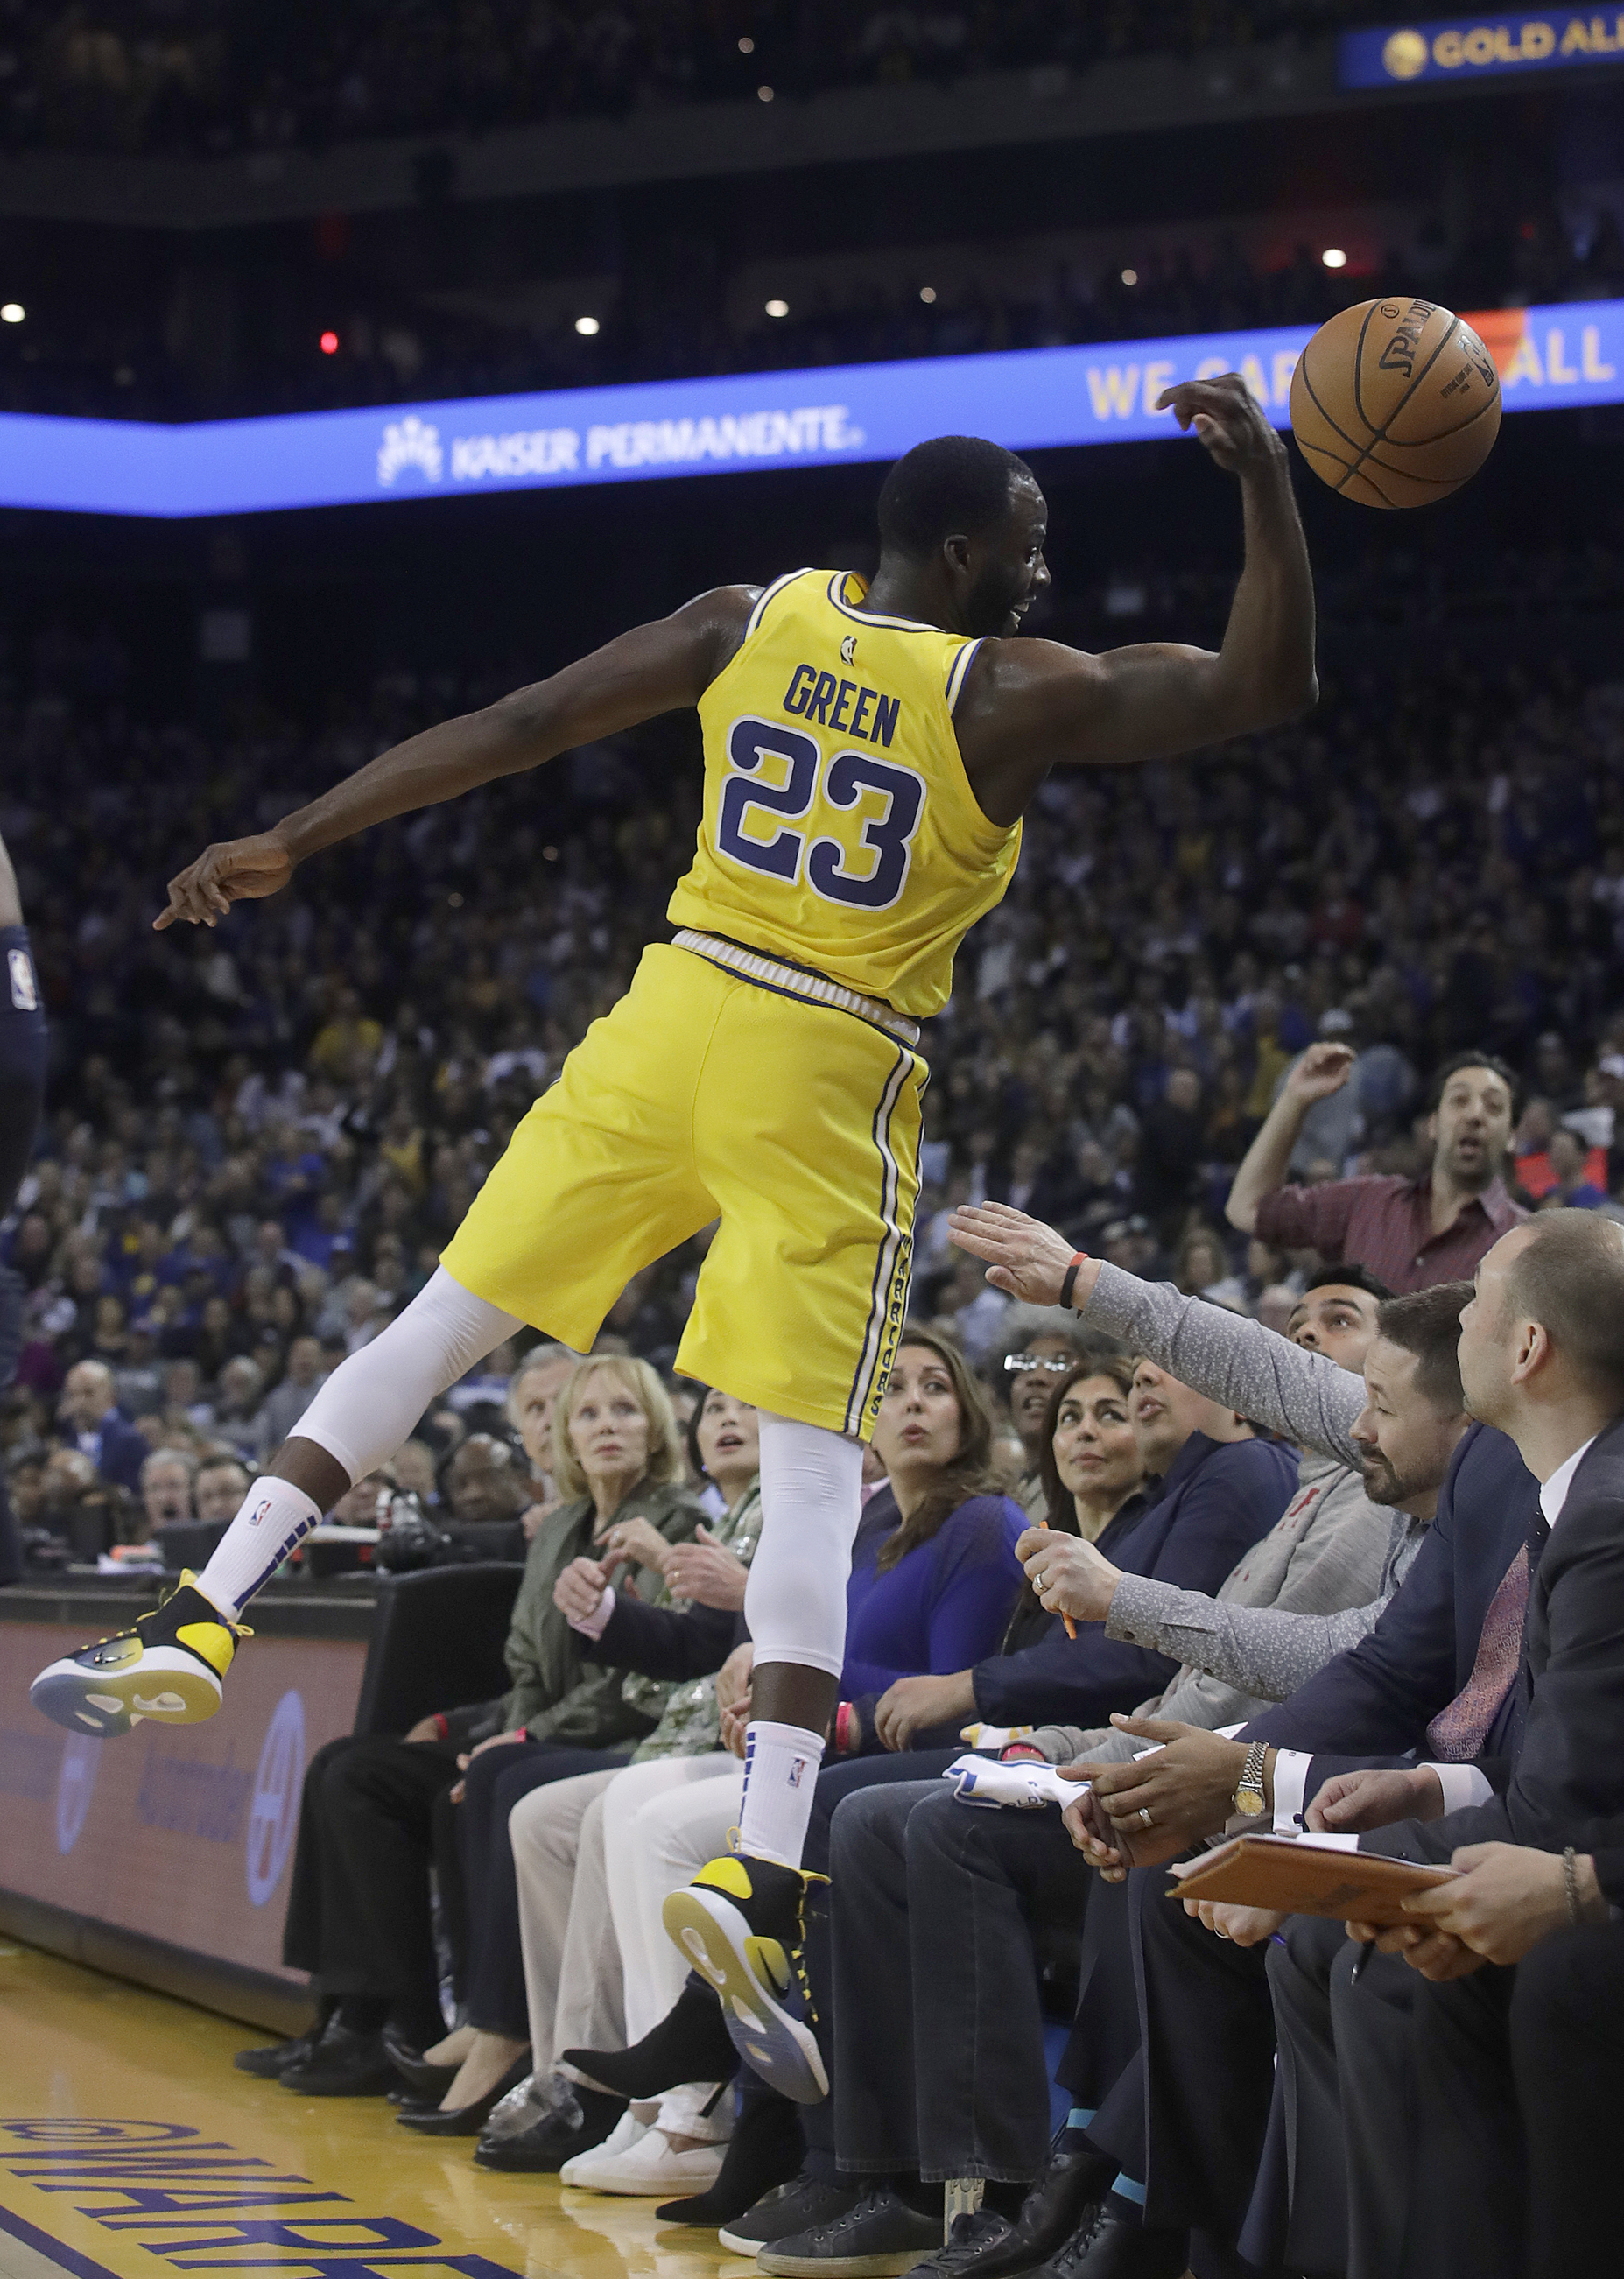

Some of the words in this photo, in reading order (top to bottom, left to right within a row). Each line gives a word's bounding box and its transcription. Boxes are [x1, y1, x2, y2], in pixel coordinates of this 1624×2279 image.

[1433, 22, 1556, 68] GOLD
[1560, 14, 1624, 57] AL
[1501, 325, 1615, 387] ALL
[1086, 360, 1176, 420] WE
[451, 427, 580, 481] KAISER
[783, 664, 901, 748] GREEN
[714, 714, 927, 912] 23
